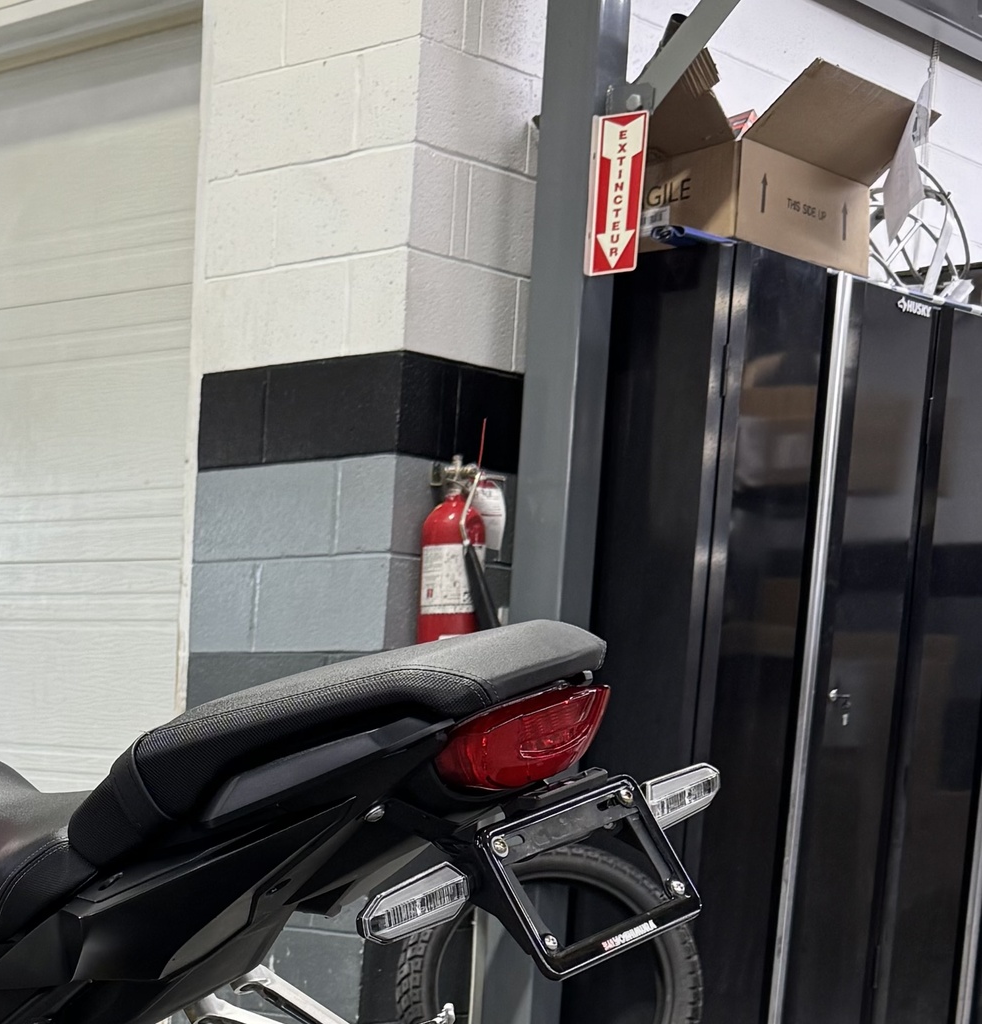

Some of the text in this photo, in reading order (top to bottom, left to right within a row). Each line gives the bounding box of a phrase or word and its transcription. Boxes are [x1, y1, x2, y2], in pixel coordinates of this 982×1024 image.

[608, 129, 628, 257] EXTINCTEUR
[643, 178, 692, 209] GILE
[786, 197, 801, 213] THIS
[802, 203, 817, 218] SIDE
[906, 299, 932, 318] HUSKY
